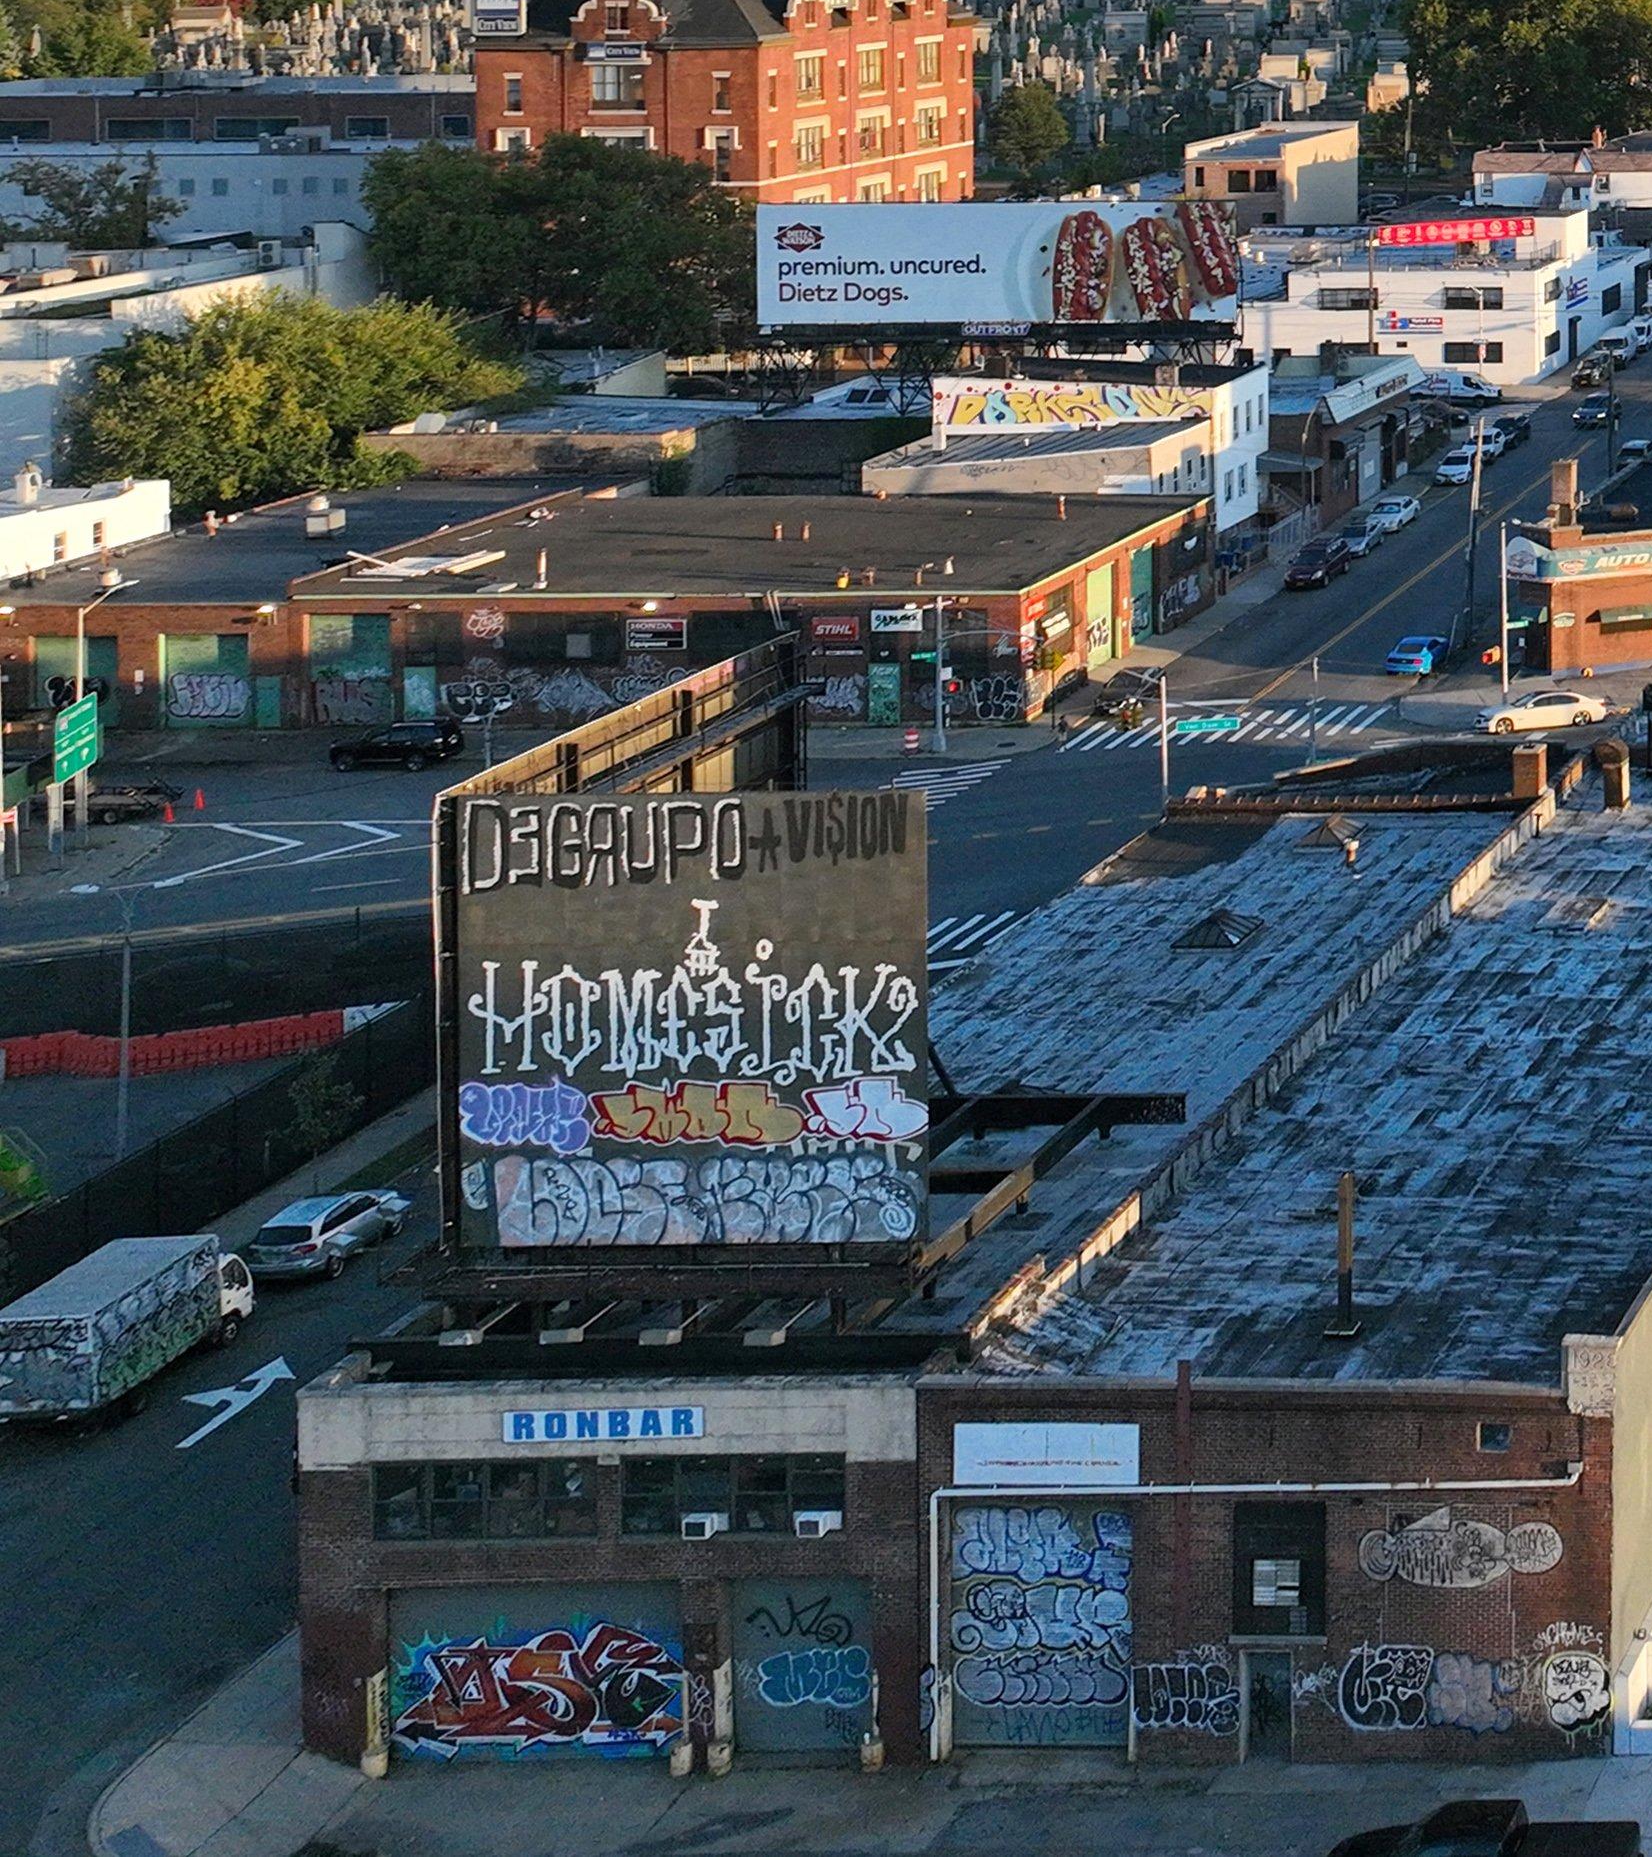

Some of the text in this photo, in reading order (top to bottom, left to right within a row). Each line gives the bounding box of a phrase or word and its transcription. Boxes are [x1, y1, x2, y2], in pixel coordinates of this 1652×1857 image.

[778, 254, 987, 280] premium. uncured.
[778, 283, 909, 306] Dietz Dogs.
[1594, 552, 1649, 569] AUTO
[630, 622, 673, 631] HONDA
[814, 624, 853, 636] STIHL
[513, 1408, 695, 1441] RONBAR
